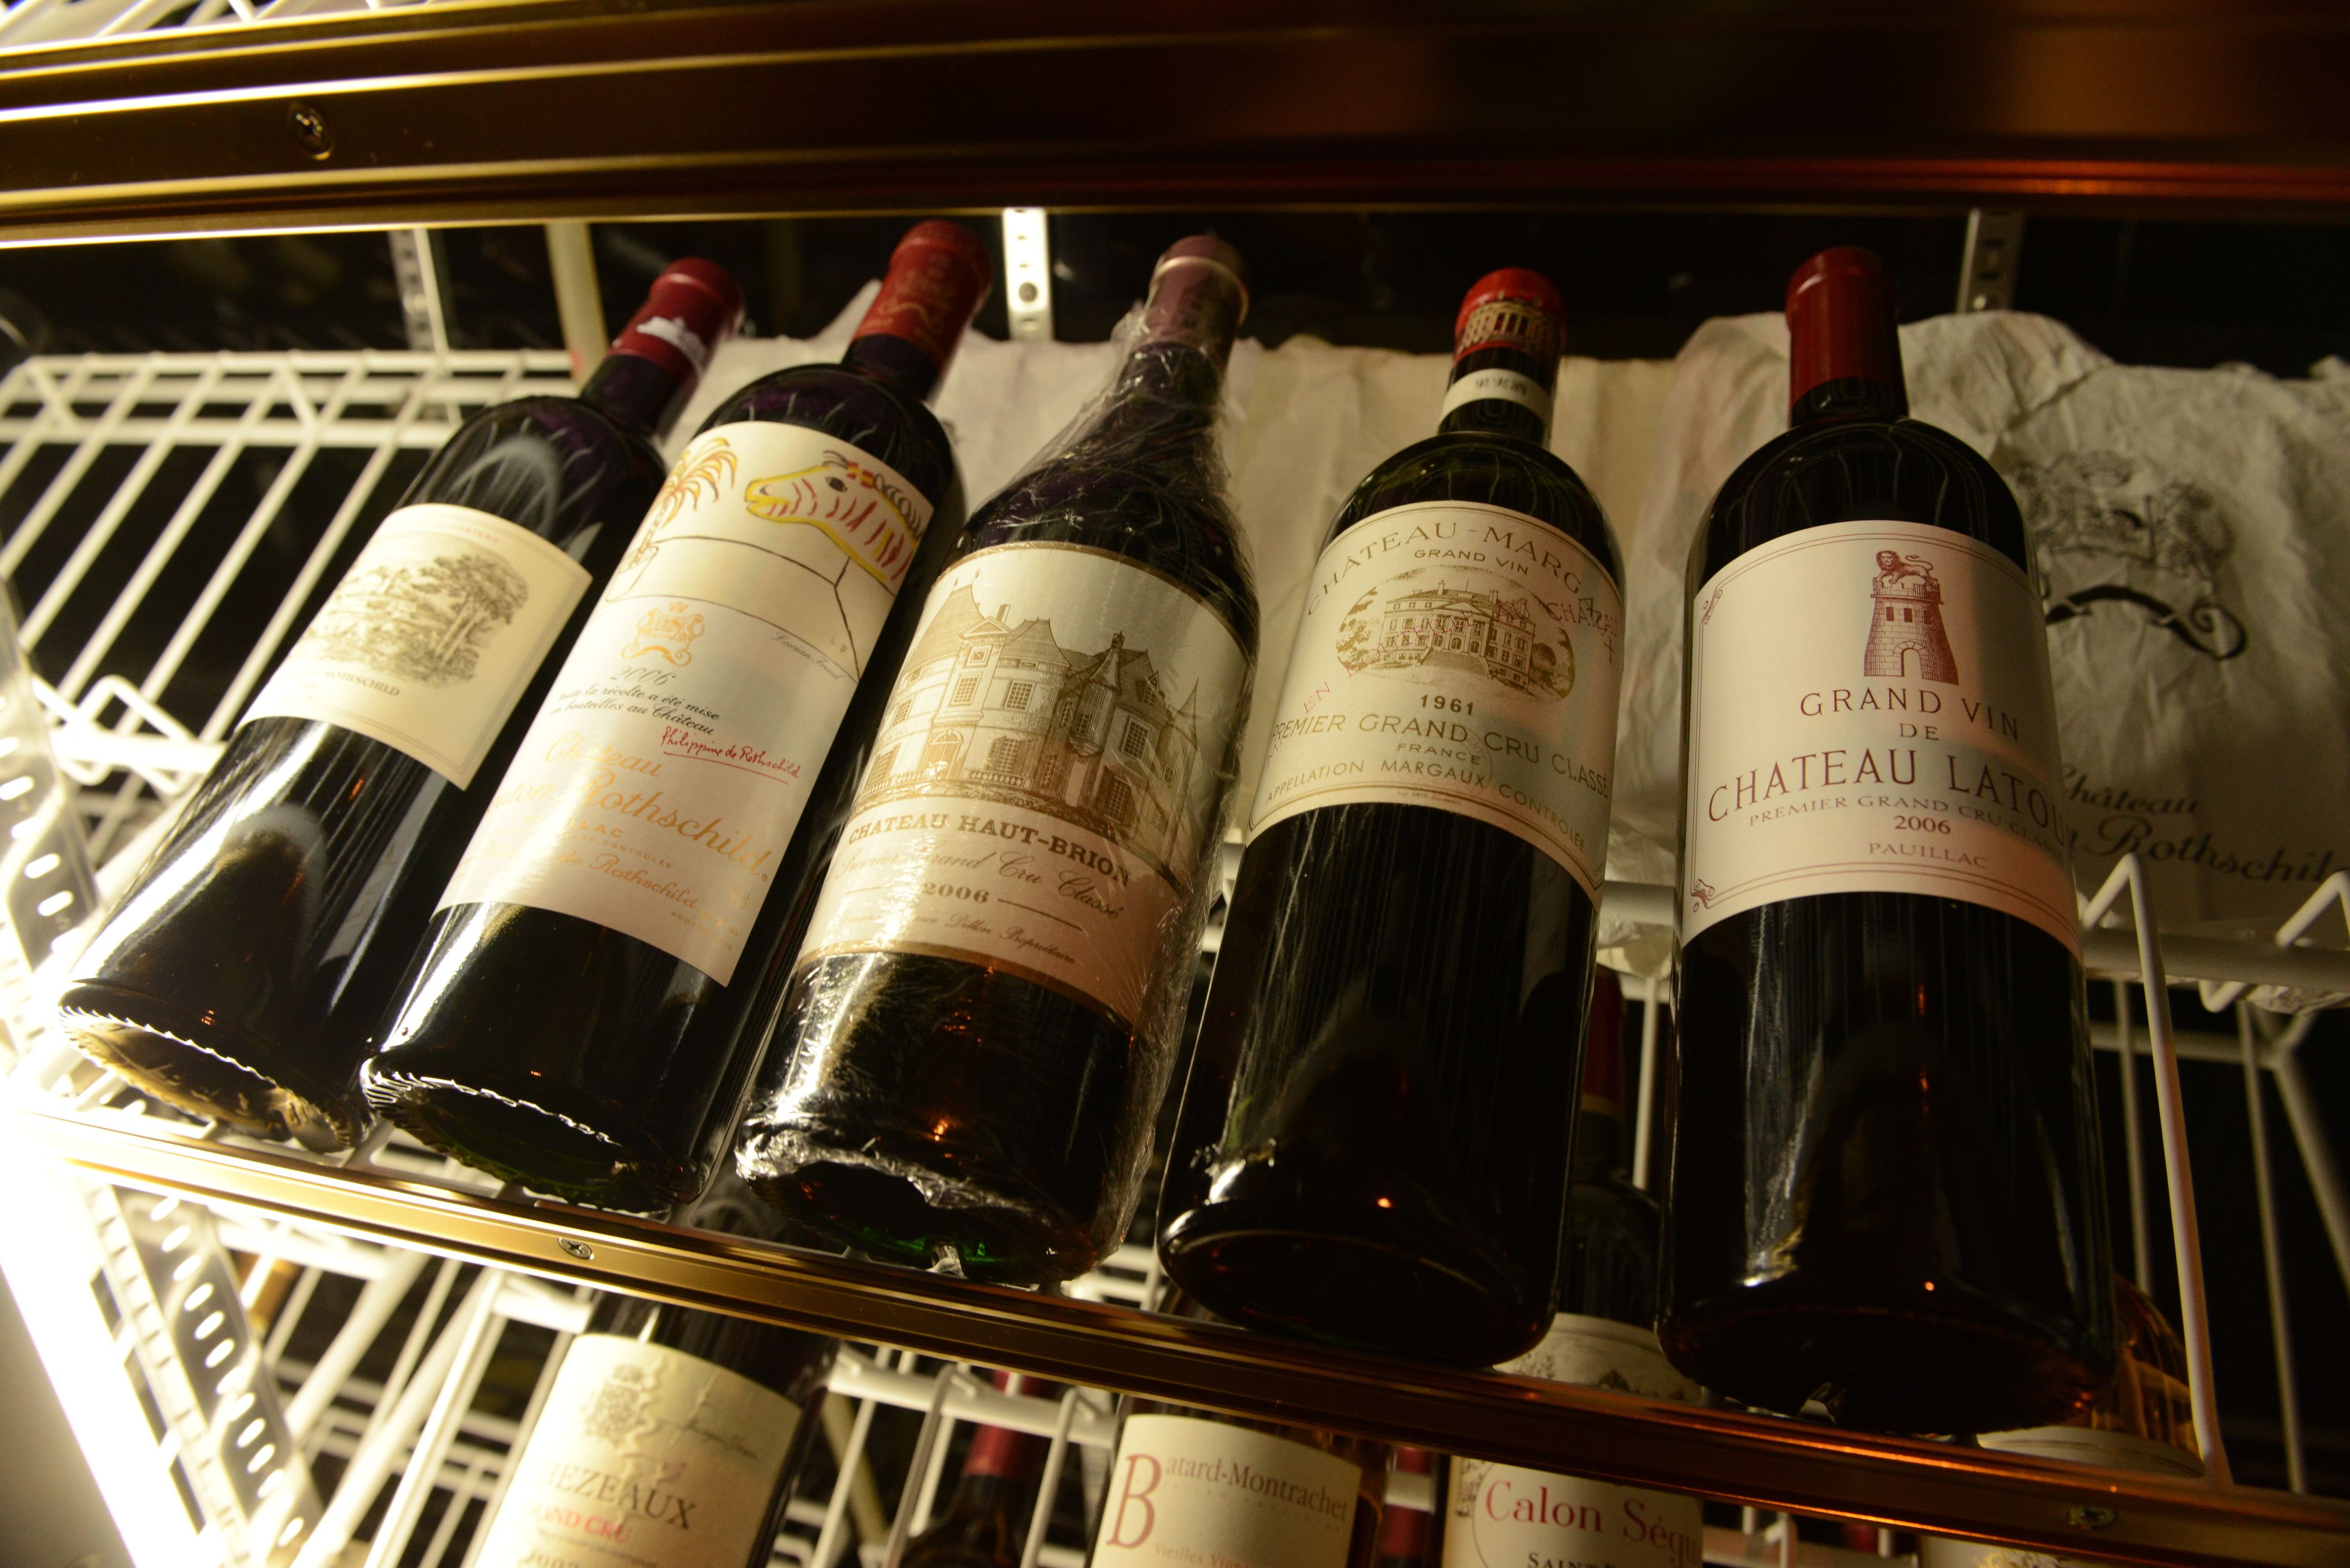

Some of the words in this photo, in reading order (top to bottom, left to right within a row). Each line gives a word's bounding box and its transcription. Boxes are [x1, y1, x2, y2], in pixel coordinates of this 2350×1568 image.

[1414, 549, 1486, 562] GRAND
[1495, 557, 1529, 575] VIN
[685, 703, 721, 722] mise
[1303, 681, 1331, 714] EN
[1420, 694, 1474, 715] 1961
[1800, 686, 1942, 716] GRAND
[1960, 697, 2019, 742] VIN
[627, 704, 649, 715] au
[652, 703, 717, 736] Château
[1899, 722, 1940, 742] DE
[1270, 714, 1346, 744] PREMIER
[1358, 713, 1468, 742] GRAND
[1483, 731, 1540, 764] CRU
[1397, 743, 1481, 765] FRANCE
[1265, 760, 1365, 804] APPELLATION
[1381, 759, 1486, 789] MARGAUX
[1708, 747, 1917, 823] CHATEAU
[1748, 797, 1849, 827] PREMIER
[1857, 794, 1949, 813] GRAND
[1958, 805, 2002, 827] CRU
[1893, 815, 1952, 835] 2006
[849, 814, 950, 845] CHATEAU
[957, 815, 1130, 887] HAUT-BRION
[1868, 842, 1988, 870] PAUILLAC
[999, 851, 1042, 884] Cru
[922, 881, 990, 904] 2006
[1485, 1480, 1603, 1533] Calon
